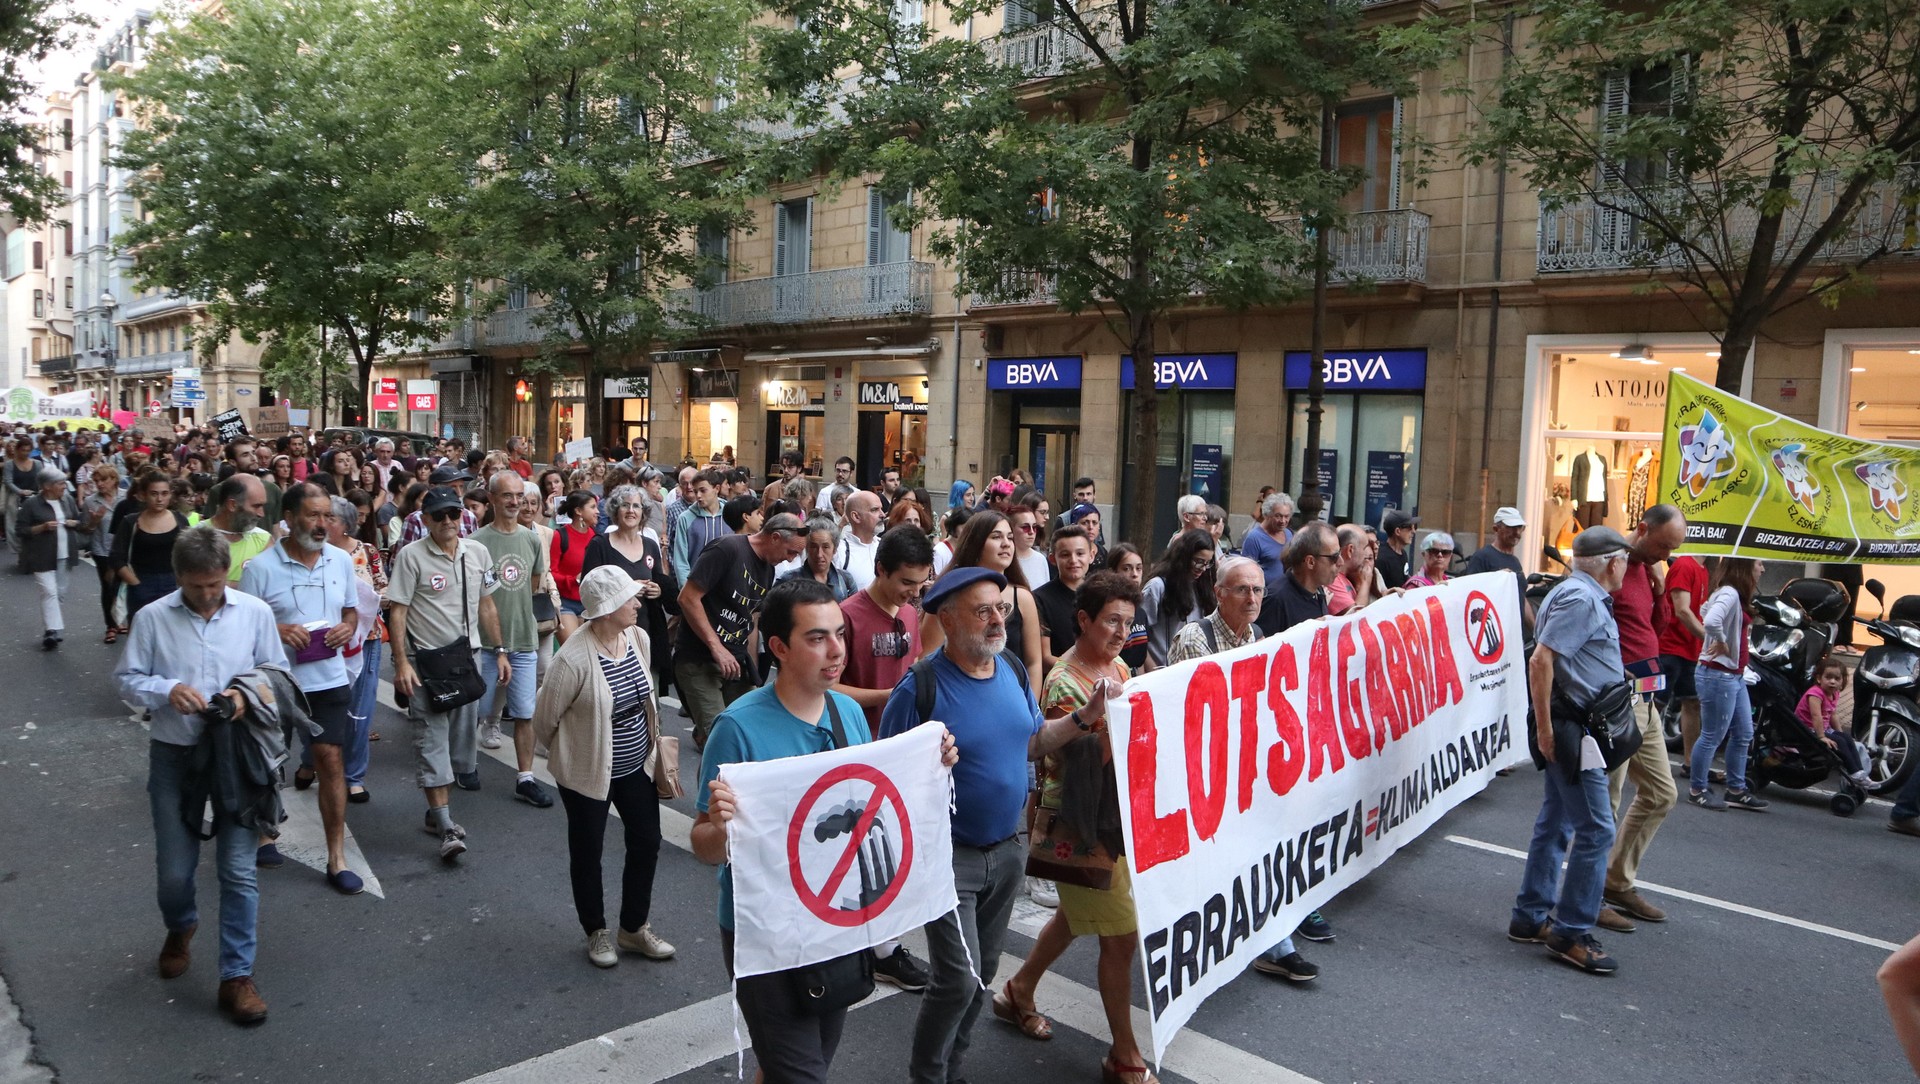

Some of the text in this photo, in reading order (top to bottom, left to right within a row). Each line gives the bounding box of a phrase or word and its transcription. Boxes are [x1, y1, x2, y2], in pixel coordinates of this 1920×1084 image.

[1006, 361, 1059, 384] BBVA
[416, 396, 431, 408] GAES
[861, 383, 900, 403] M&M
[38, 407, 83, 417] KLIMA
[1721, 469, 1748, 499] ASKO
[1707, 526, 1727, 539] BAI!
[1754, 532, 1848, 552] BIRZIKLATZEA BAI!
[1126, 595, 1464, 874] LOTSAGARRIA
[1144, 799, 1364, 1023] ERRAUSKETA
